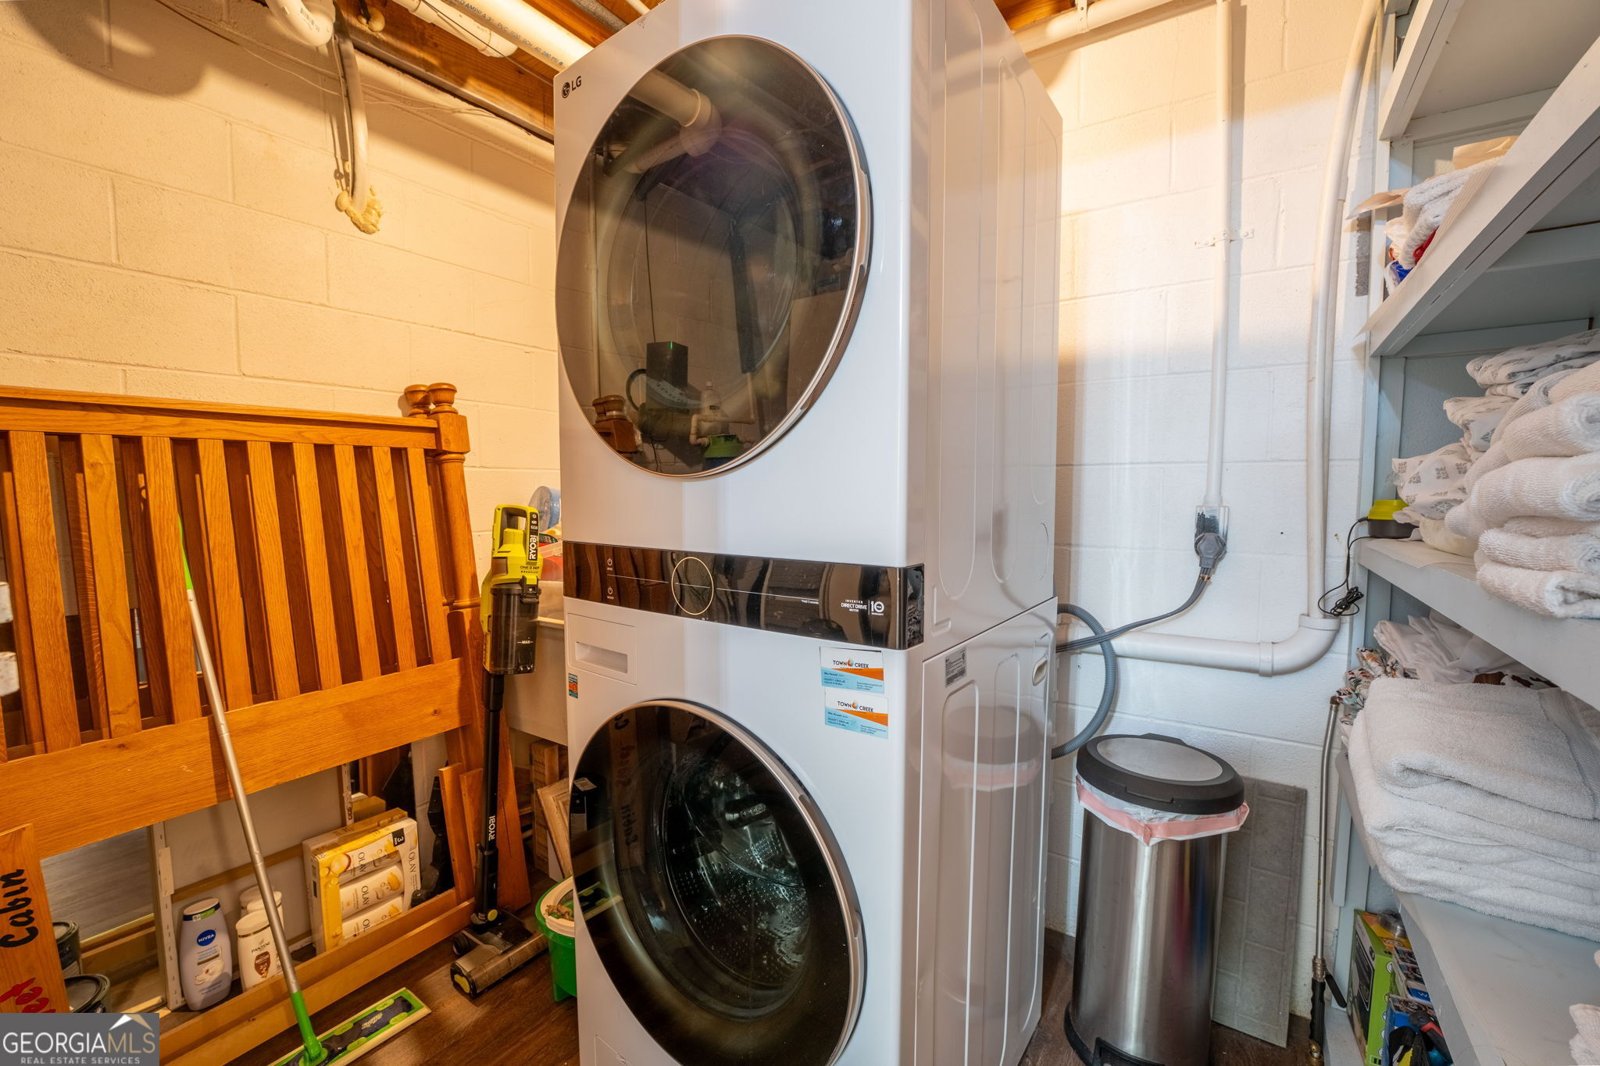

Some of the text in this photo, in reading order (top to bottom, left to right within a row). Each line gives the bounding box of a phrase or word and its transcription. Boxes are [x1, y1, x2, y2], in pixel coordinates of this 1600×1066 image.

[571, 75, 582, 92] LG
[529, 535, 538, 560] RYOBI
[870, 601, 885, 613] 10
[488, 815, 496, 841] RYOBI
[396, 835, 404, 843] 3
[358, 851, 367, 873] OLAY
[407, 851, 417, 873] OLAY
[361, 885, 369, 906] OLAY
[0, 869, 39, 948] Cabin
[197, 933, 215, 943] NIVEA
